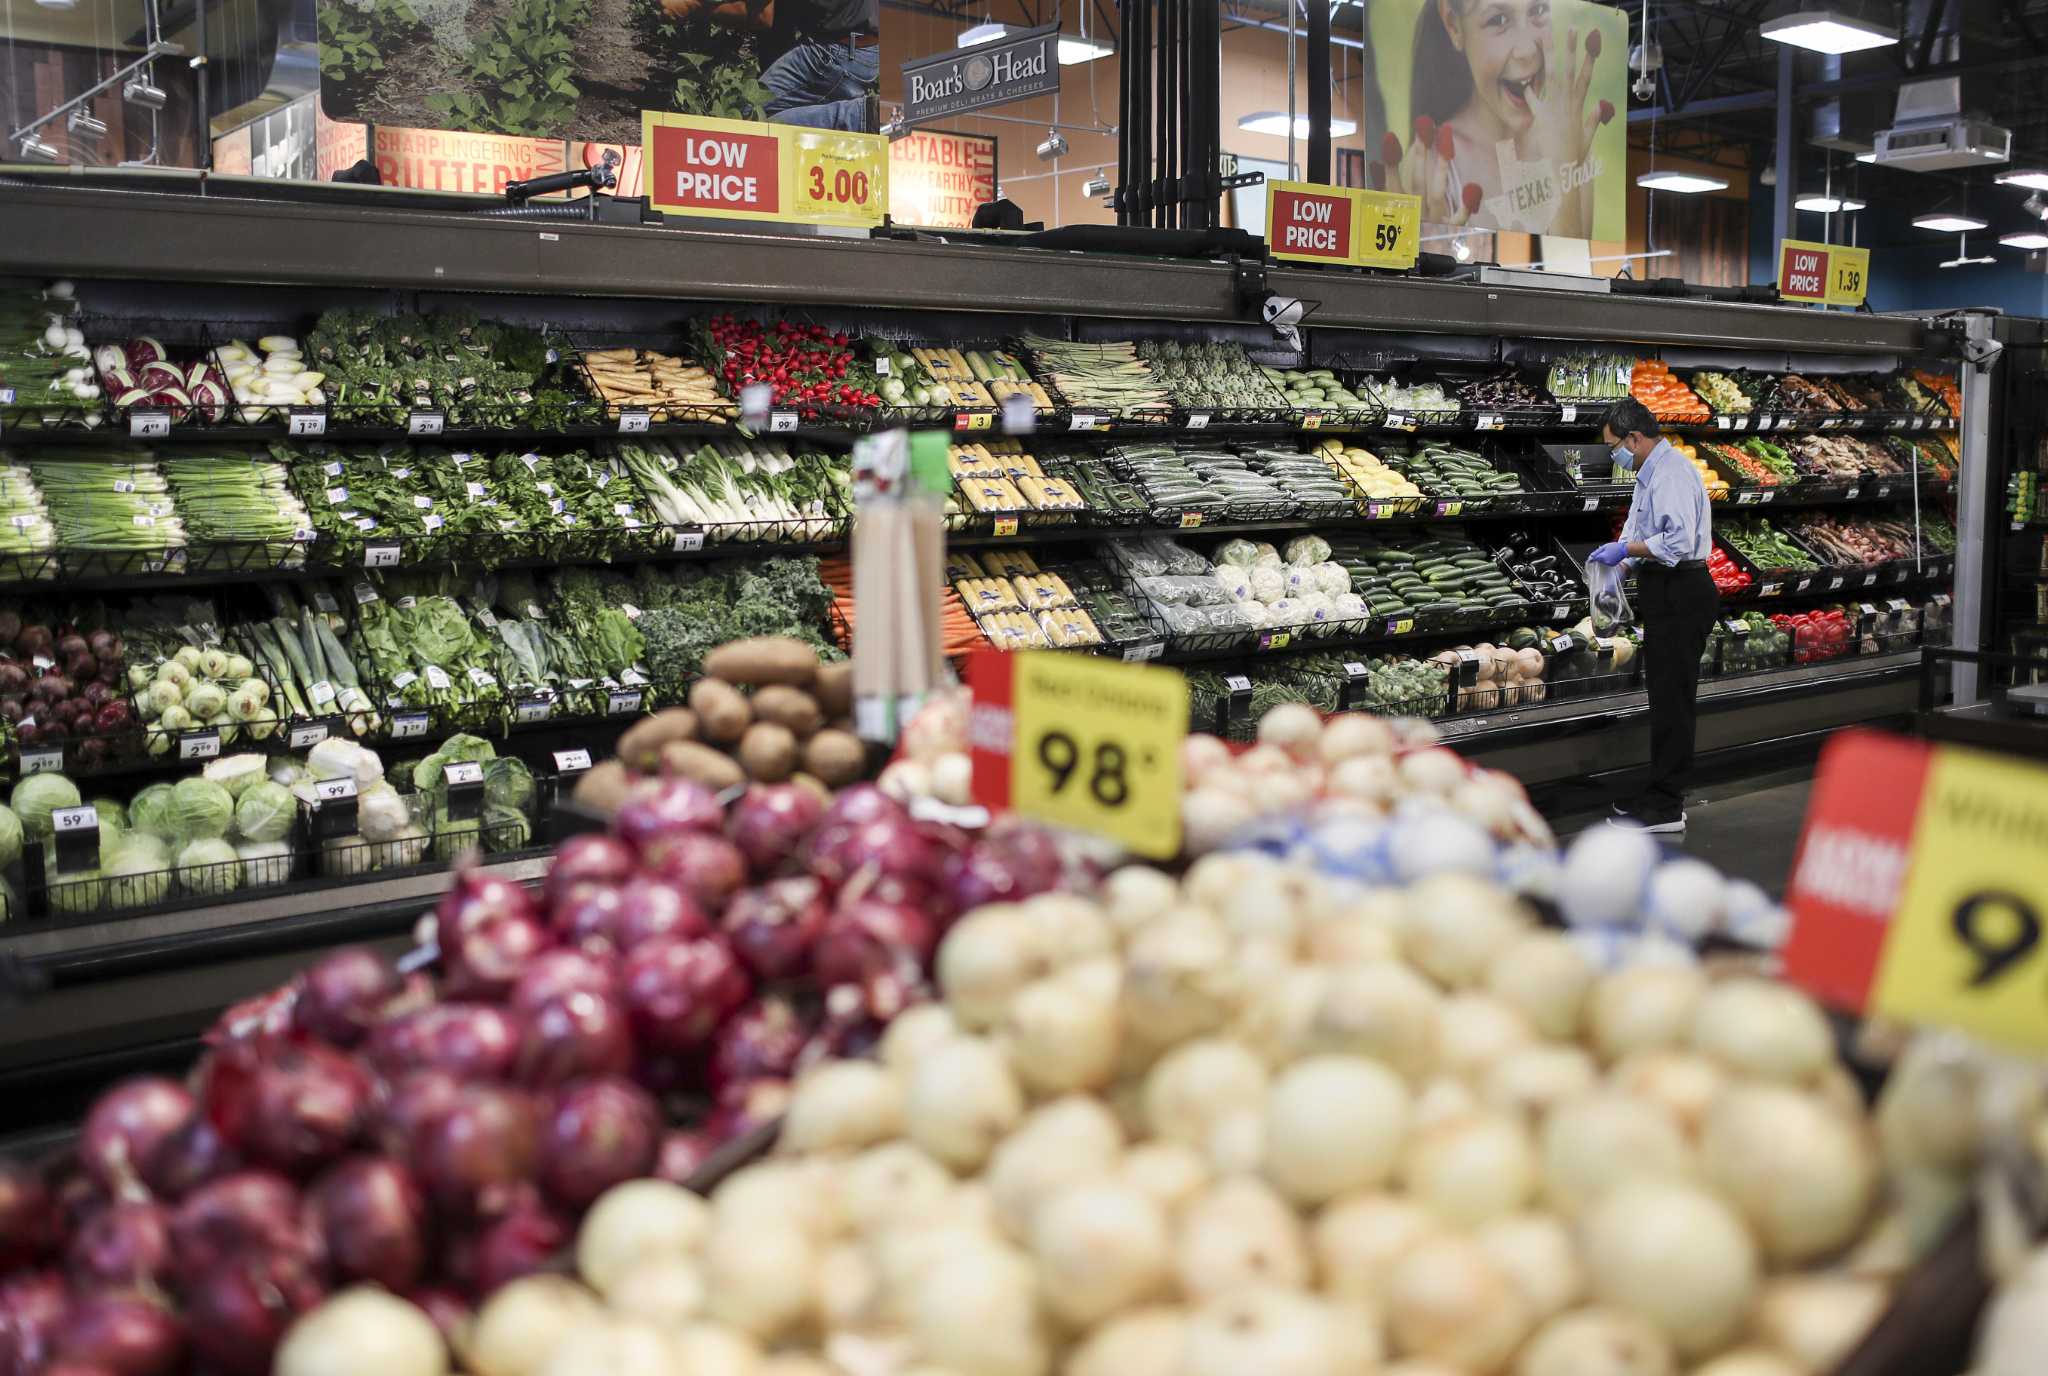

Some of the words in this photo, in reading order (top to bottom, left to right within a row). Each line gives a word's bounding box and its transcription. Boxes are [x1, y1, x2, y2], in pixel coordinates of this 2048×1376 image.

[912, 65, 963, 104] Boar's
[993, 41, 1046, 85] Head
[916, 102, 948, 115] PREMIUM
[971, 92, 995, 103] MEATS
[1006, 80, 1045, 95] CHEESES
[377, 130, 439, 155] SHARP
[441, 135, 531, 163] LINGERING
[686, 138, 748, 168] LOW
[892, 135, 974, 169] ECTABLE
[676, 171, 758, 203] PRICE
[808, 165, 869, 206] 3.00
[974, 143, 993, 203] CATE
[1507, 176, 1554, 213] TEXAS
[1293, 200, 1332, 224] LOW
[1286, 226, 1336, 250] PRICE
[1794, 254, 1818, 272] LOW
[1789, 275, 1820, 292] PRICE
[1838, 270, 1860, 292] 1.39
[1953, 890, 2041, 991] 9
